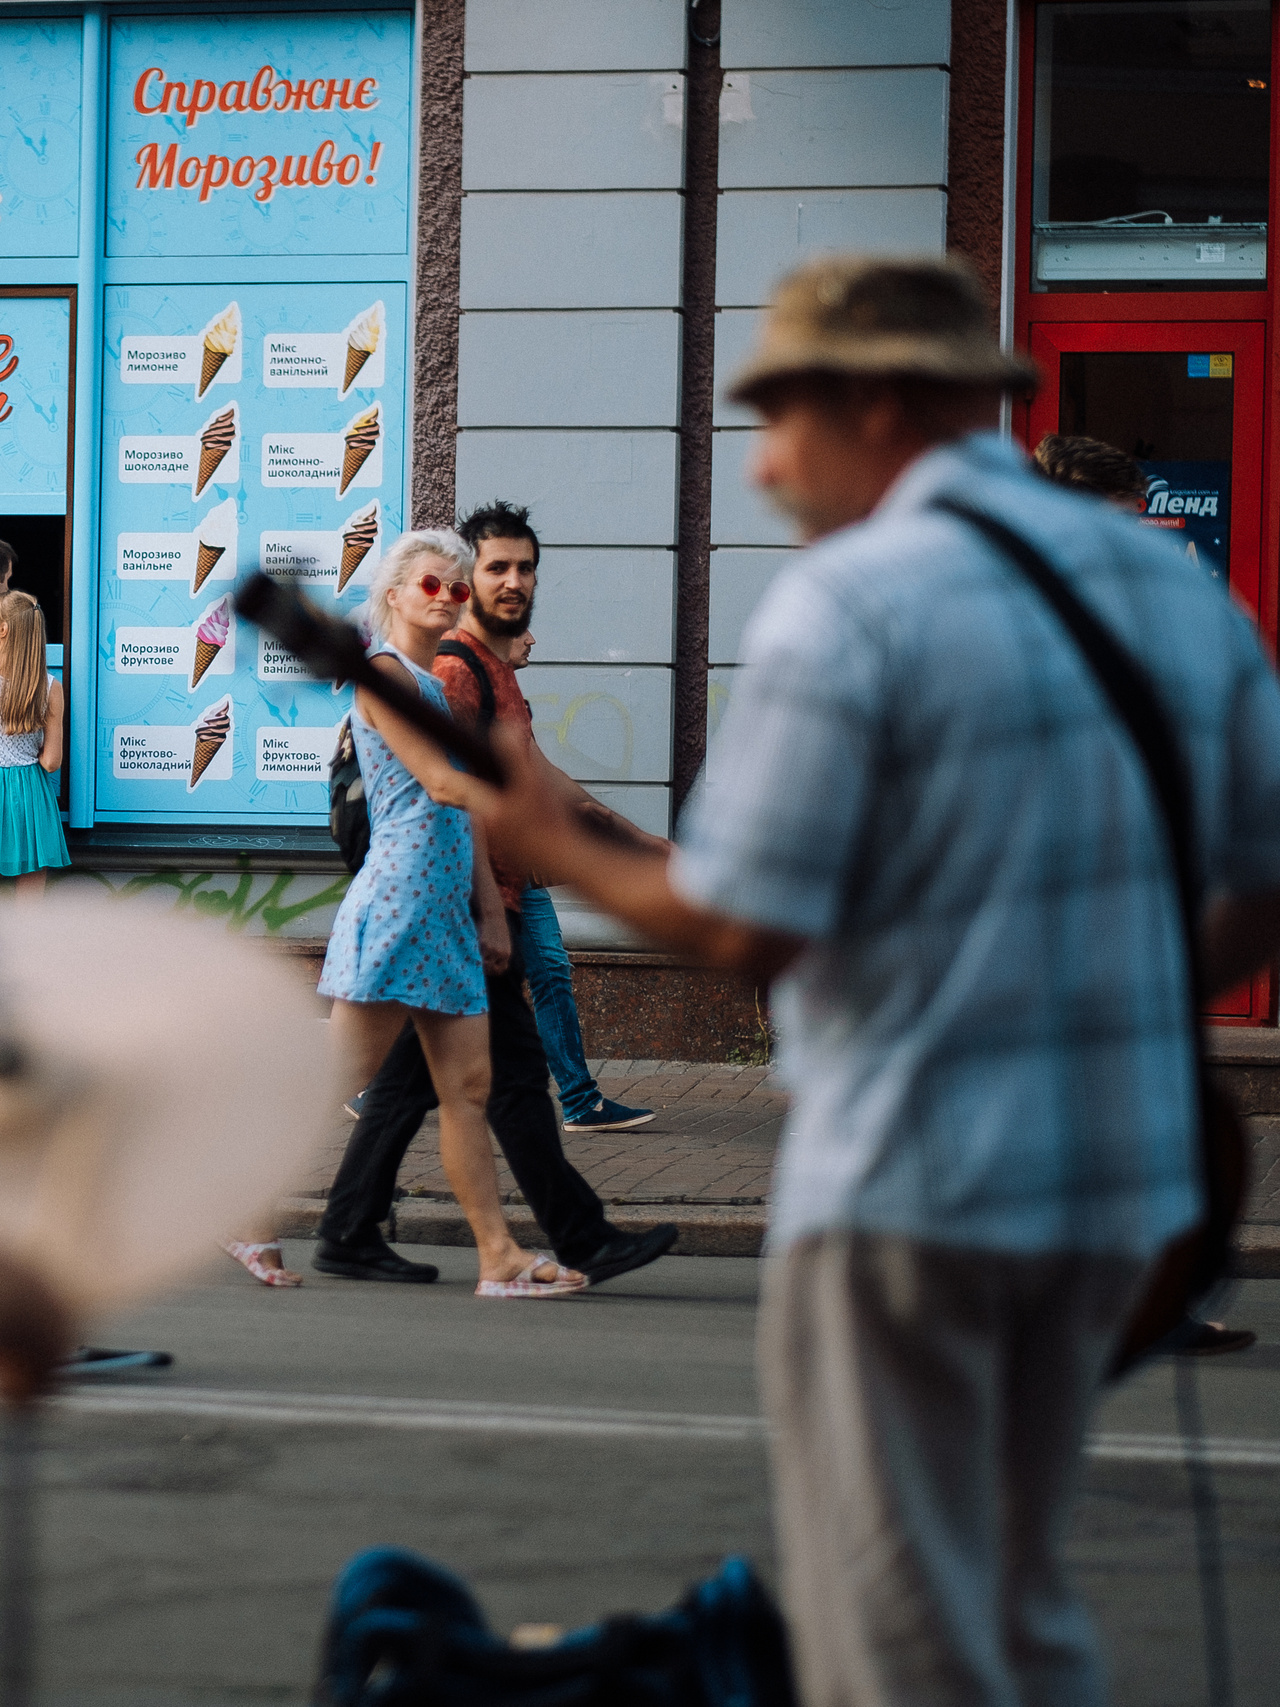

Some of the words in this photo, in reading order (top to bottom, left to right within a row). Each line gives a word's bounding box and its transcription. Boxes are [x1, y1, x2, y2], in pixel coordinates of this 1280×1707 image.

[133, 65, 378, 127] Справжнє
[135, 140, 382, 201] Морозиво!
[271, 343, 297, 353] Мікс
[127, 350, 186, 361] Морозиво
[270, 356, 326, 364] лимонно-
[127, 363, 178, 372] лимонне
[270, 366, 328, 376] ванільний
[269, 445, 295, 454] Мікс
[125, 450, 183, 461] Морозиво
[124, 462, 189, 472] шоколадне
[268, 458, 324, 466] лимонно-
[268, 468, 340, 479] шоколадний
[266, 543, 291, 553] Мікс
[123, 549, 181, 560] Морозиво
[266, 555, 320, 564] ванільно-
[123, 561, 172, 570] ванільне
[266, 566, 338, 577] шоколадний
[121, 644, 179, 655] Морозиво
[264, 641, 289, 651] Мік
[121, 655, 173, 666] фруктове
[264, 653, 309, 663] фрукт
[264, 664, 311, 674] ванільн
[120, 737, 146, 746] Мікс
[263, 739, 289, 748] Мікс
[120, 749, 177, 759] фруктово-
[263, 751, 320, 761] фруктово-
[120, 760, 192, 771] шоколадний
[262, 762, 321, 772] лимонний
